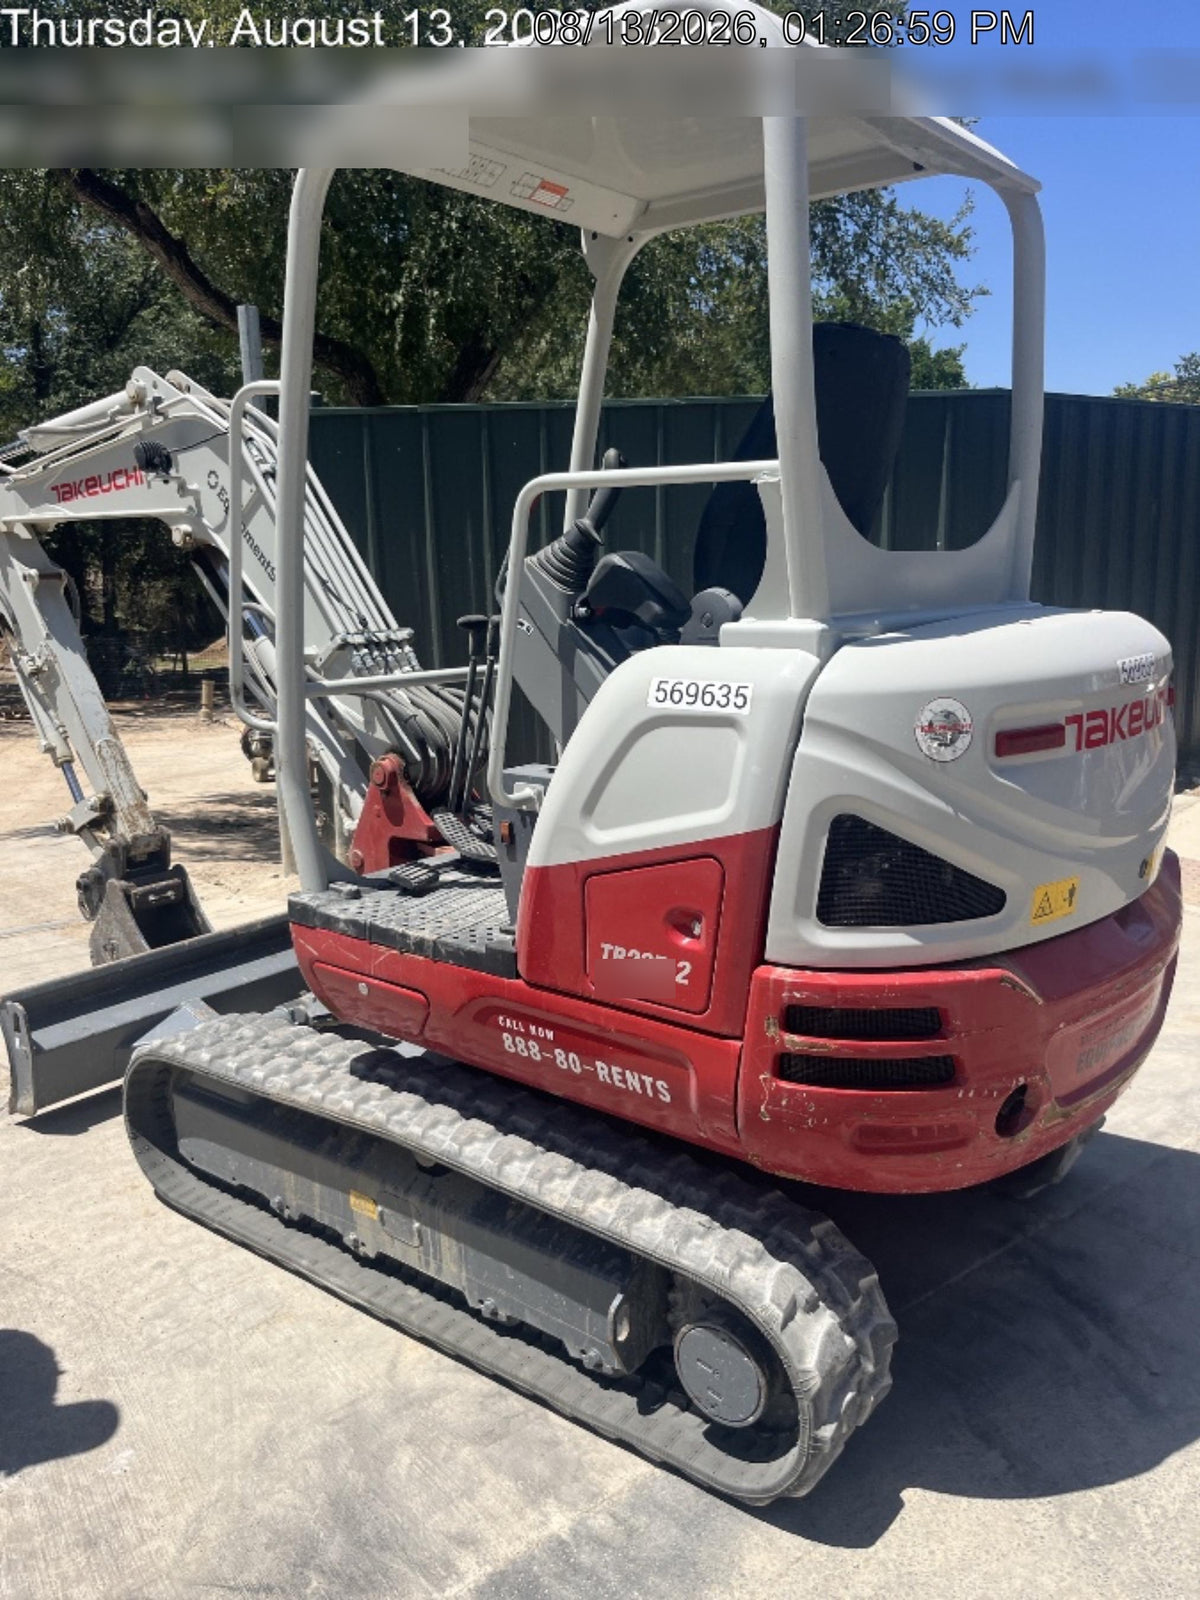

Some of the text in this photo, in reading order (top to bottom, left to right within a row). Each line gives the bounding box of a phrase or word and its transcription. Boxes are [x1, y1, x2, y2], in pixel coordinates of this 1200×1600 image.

[655, 680, 749, 709] 569635
[498, 1014, 554, 1041] CALL NOW
[502, 1032, 671, 1103] 888-80-RENTS
